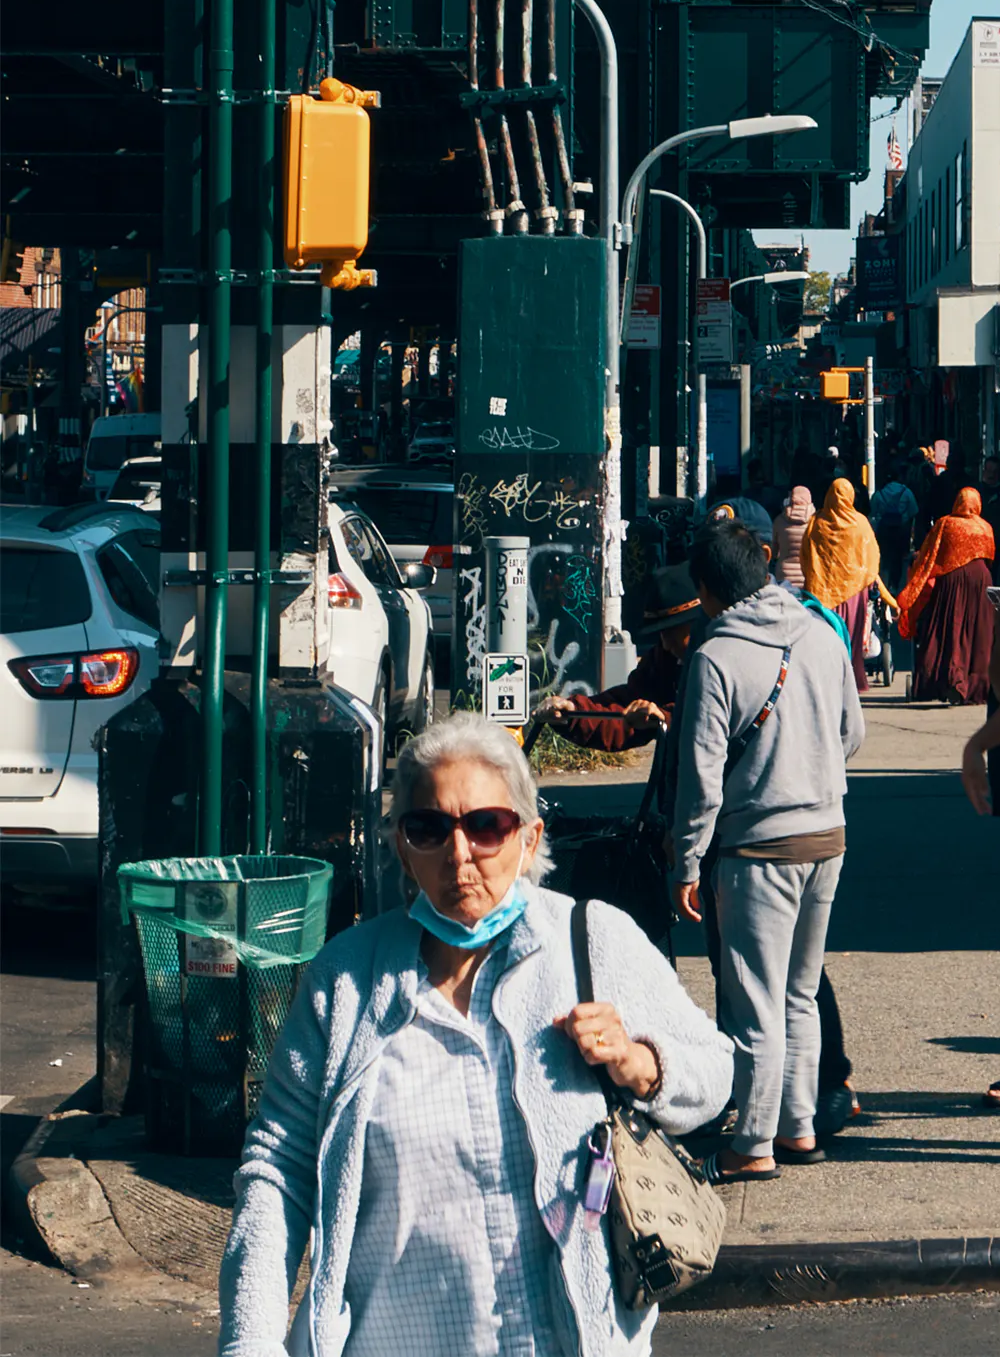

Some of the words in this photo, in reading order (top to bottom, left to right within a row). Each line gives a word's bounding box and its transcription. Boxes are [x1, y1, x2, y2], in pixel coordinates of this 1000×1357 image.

[517, 567, 523, 576] N
[512, 576, 526, 585] DIE
[188, 960, 210, 972] $100
[213, 962, 236, 973] FINE
